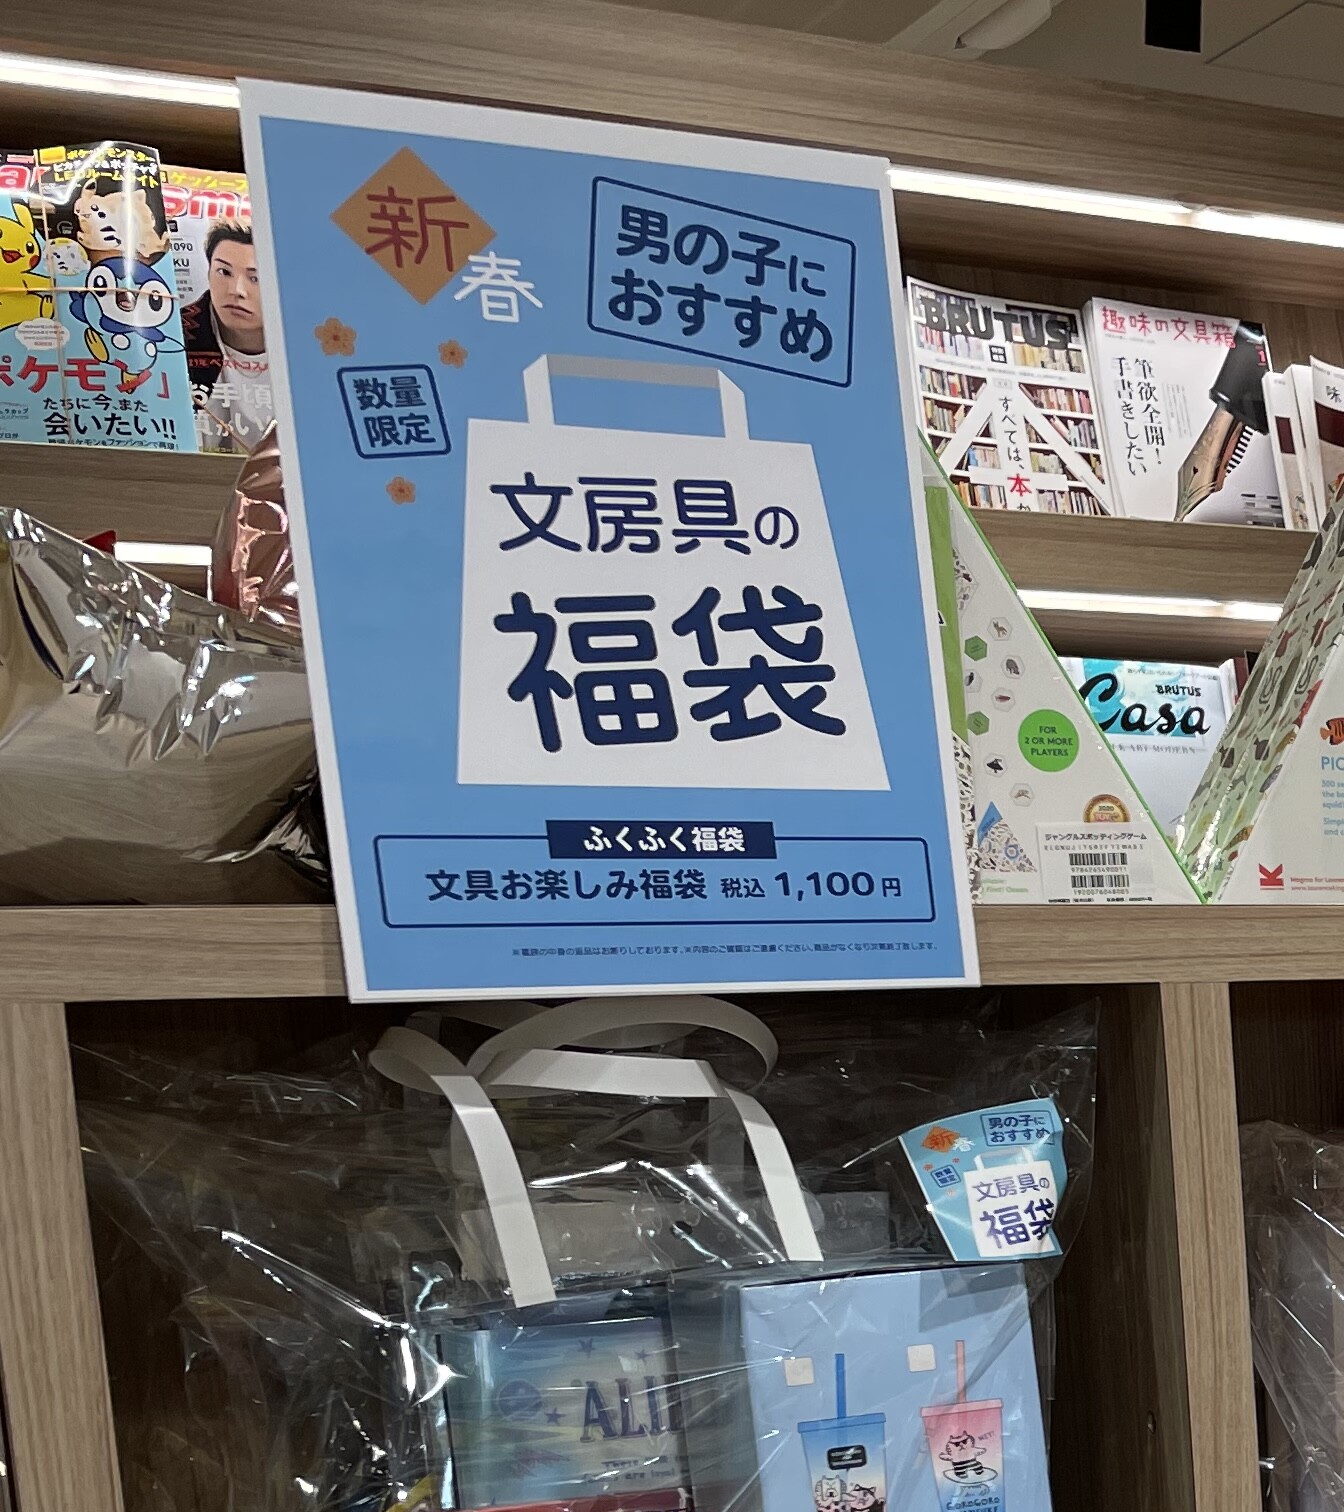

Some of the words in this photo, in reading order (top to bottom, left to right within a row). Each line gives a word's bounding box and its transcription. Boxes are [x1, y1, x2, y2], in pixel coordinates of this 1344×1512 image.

[619, 205, 827, 297] 男の子に
[607, 270, 833, 365] おすすめ
[920, 295, 1072, 350] BRUTUS
[1100, 306, 1237, 349] 趣味の文具箱
[352, 375, 423, 411] 数量
[361, 412, 437, 448] 限定
[1113, 356, 1148, 476] 手書きしたい
[489, 473, 800, 554] 文房具の
[493, 585, 846, 754] 福袋
[1077, 672, 1211, 735] Casa
[1156, 683, 1201, 697] BRUTUS
[1024, 737, 1031, 746] 2
[1033, 737, 1046, 746] OR
[1048, 736, 1074, 746] MORE
[1039, 725, 1058, 735] FOR
[1031, 748, 1069, 758] PLAYERS
[583, 826, 746, 853] ふくふく福袋
[425, 869, 708, 901] 文具お楽しみ福袋
[721, 878, 766, 899] 税込
[988, 1114, 1045, 1130] 男の子に
[990, 1128, 1050, 1144] おすすめ
[972, 1173, 1050, 1202] 文房具の
[979, 1198, 1054, 1249] 福袋
